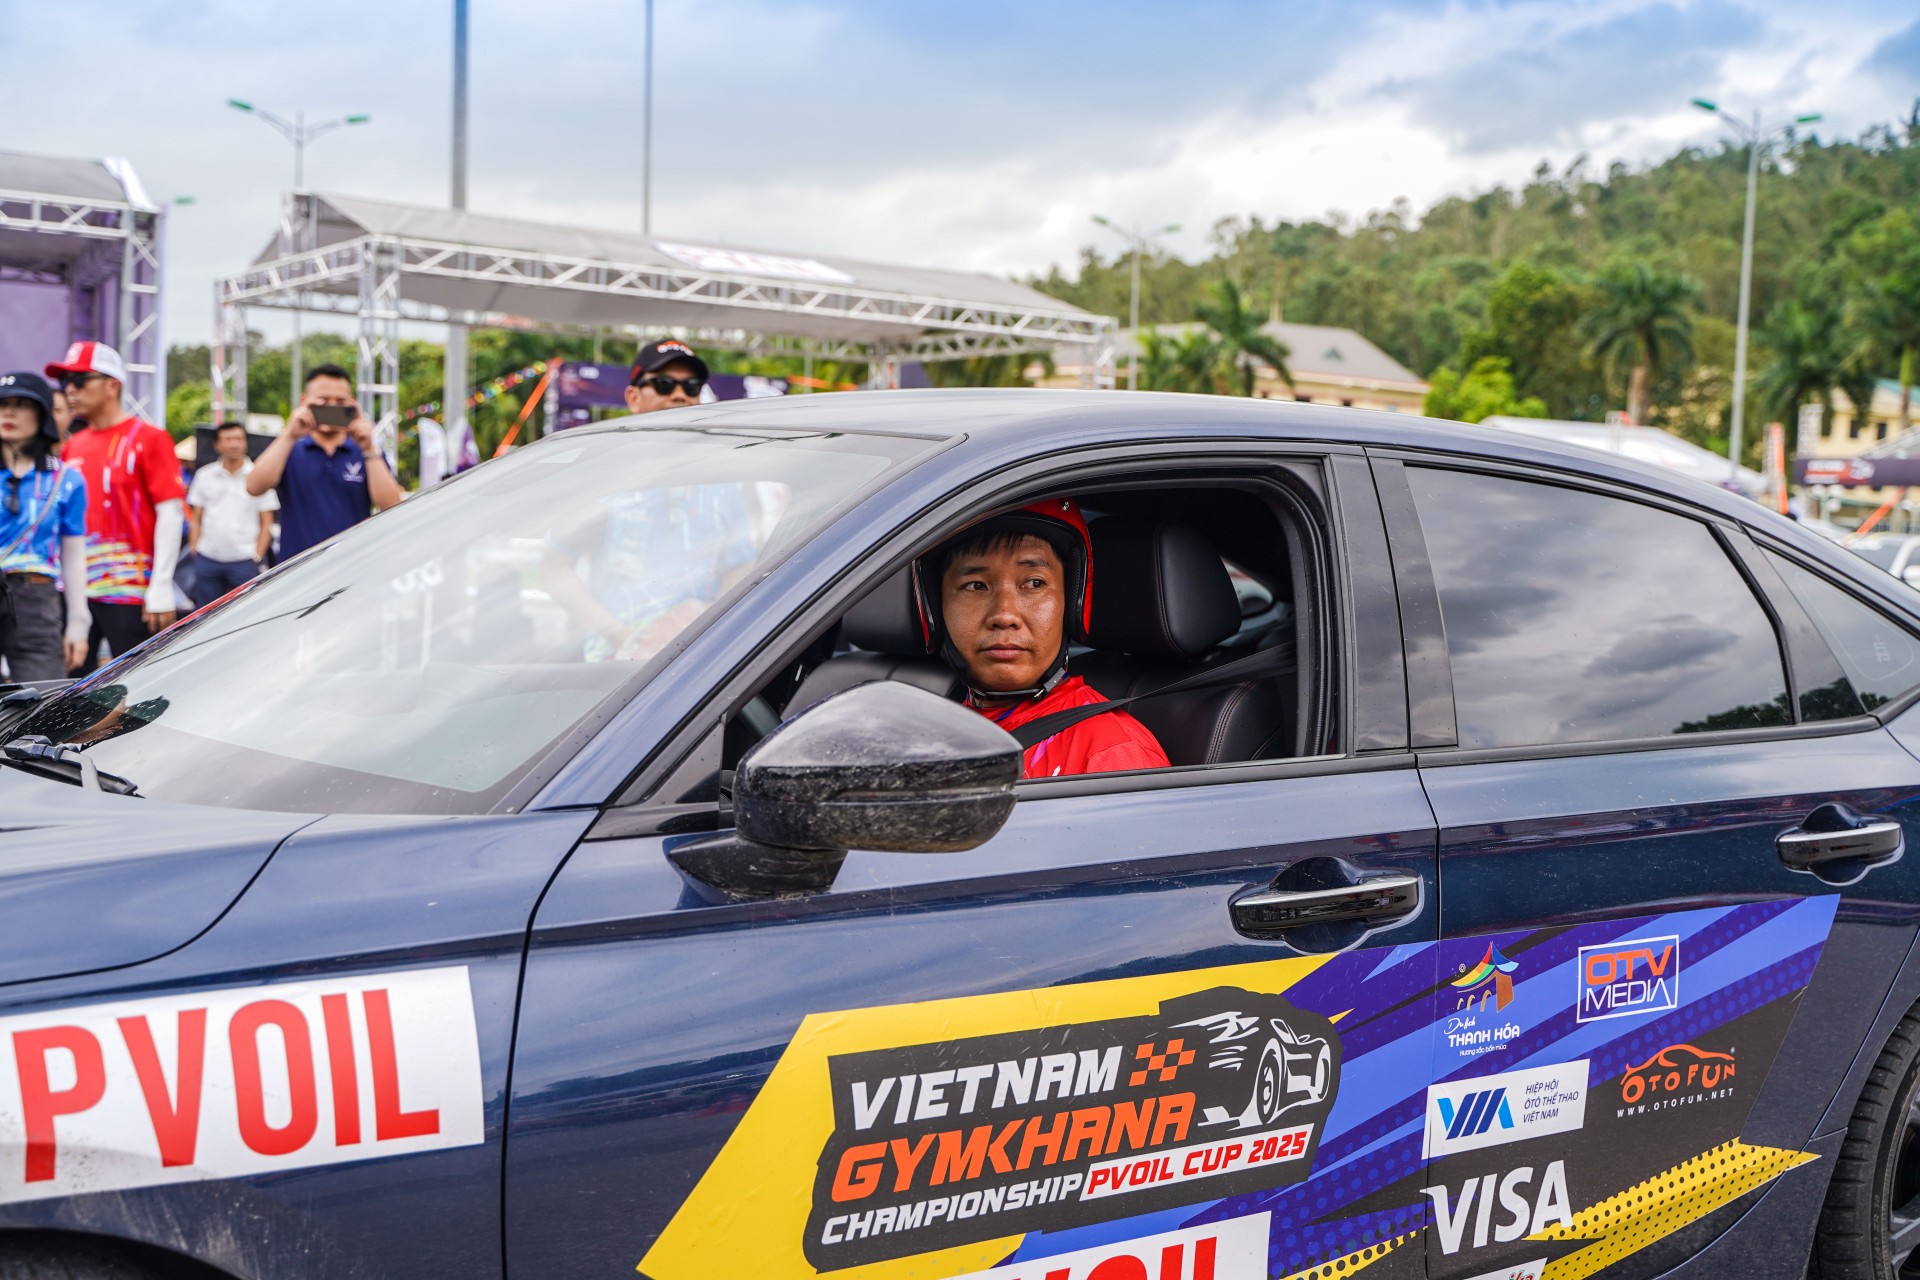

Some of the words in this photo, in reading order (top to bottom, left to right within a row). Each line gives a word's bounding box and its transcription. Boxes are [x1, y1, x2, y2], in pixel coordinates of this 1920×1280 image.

[1586, 945, 1673, 985] OTV
[1585, 977, 1673, 1012] MEDIA
[1448, 1029, 1491, 1048] THANH
[1494, 1022, 1521, 1041] HÓA
[12, 989, 440, 1184] PVOIL
[851, 1045, 1123, 1131] VIETNAM
[1523, 1095, 1541, 1110] ÔTÔ
[1558, 1090, 1579, 1103] THAO
[1525, 1081, 1544, 1096] HIỆP
[1544, 1078, 1560, 1092] HỘI
[1617, 1087, 1734, 1118] WWW.OTOFUN.NET
[1622, 1063, 1735, 1103] OTOFUN
[1522, 1109, 1541, 1125] VIỆT
[1541, 1107, 1559, 1120] NAM
[831, 1091, 1196, 1203] GYMKHANA
[821, 1173, 1083, 1245] CHAMPIONSHIP
[1087, 1158, 1175, 1195] PVOIL
[1182, 1143, 1243, 1176] CUP
[1247, 1131, 1308, 1164] 2025
[1418, 1159, 1574, 1256] VISA
